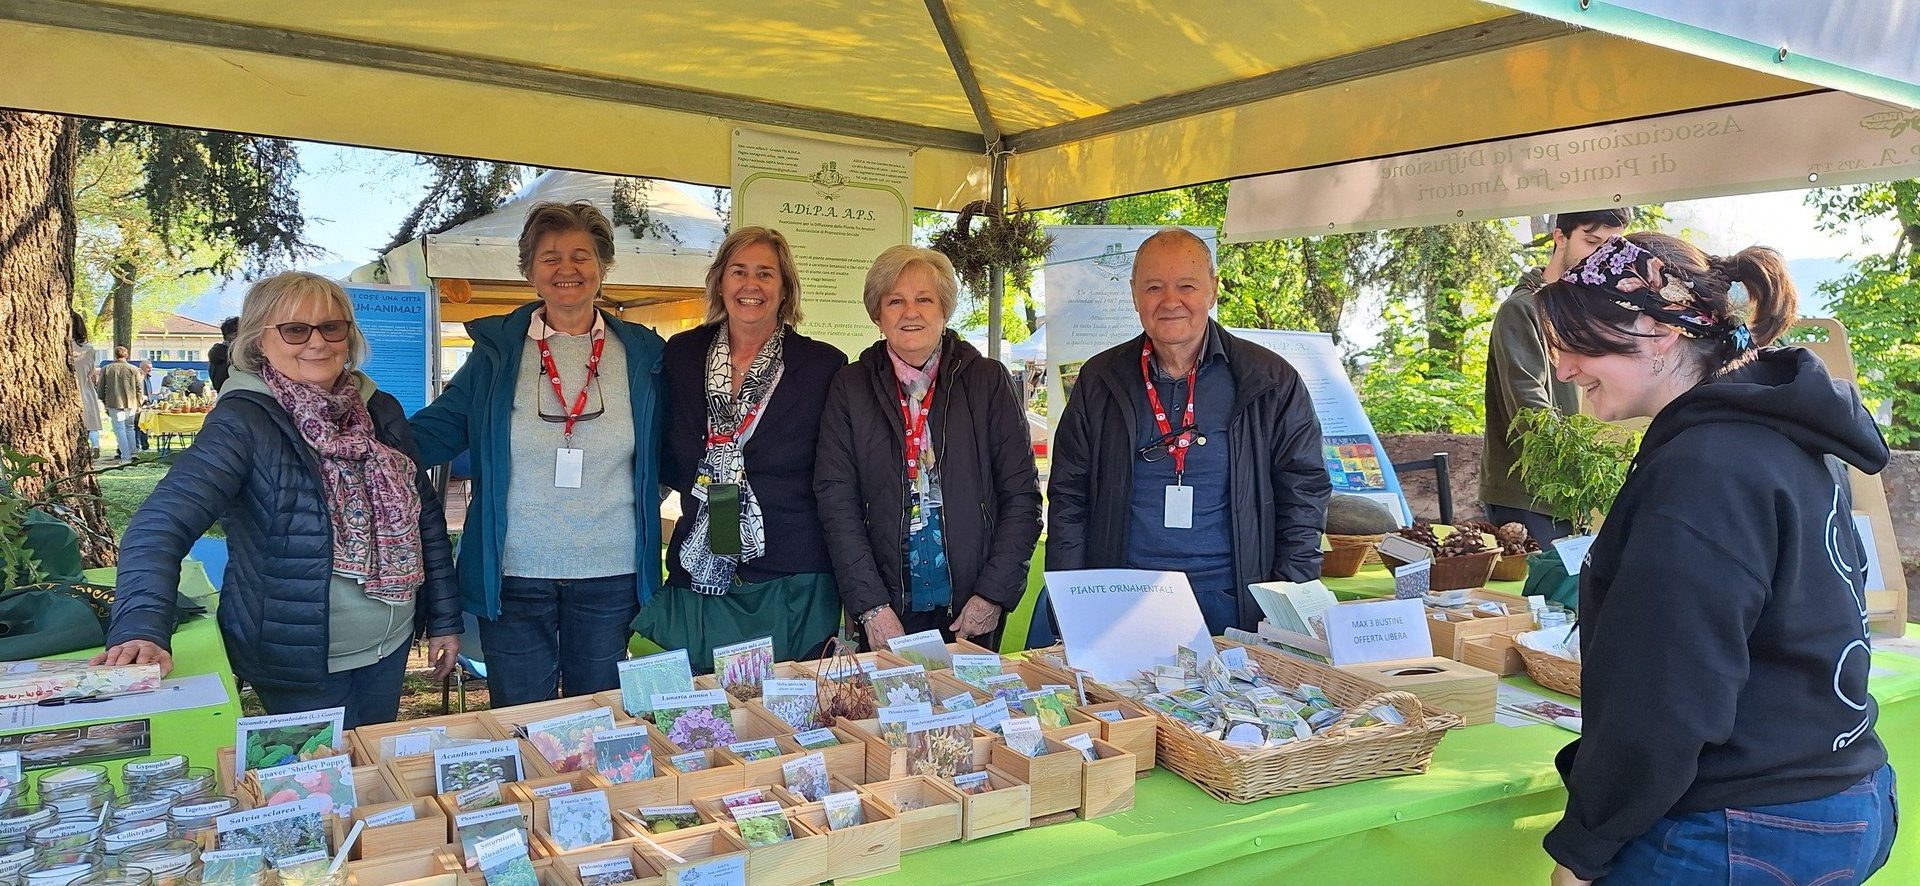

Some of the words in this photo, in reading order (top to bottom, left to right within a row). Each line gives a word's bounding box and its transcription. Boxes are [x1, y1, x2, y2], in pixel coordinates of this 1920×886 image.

[842, 208, 875, 221] A.P.S.
[353, 303, 422, 314] UM-ANIMAL?
[1070, 584, 1107, 595] PIANTE
[1108, 584, 1175, 594] ORNAMENTALI
[1352, 620, 1368, 628] MAX
[1375, 617, 1404, 627] BUSTINE
[1353, 634, 1383, 644] OFFERTA
[1384, 632, 1408, 641] LIBERA
[662, 693, 687, 701] Lunaria
[441, 750, 478, 760] Acanthus
[480, 746, 503, 755] mollis
[136, 761, 170, 770] Gypsophila
[260, 769, 286, 779] apaver
[230, 814, 260, 824] Salvia
[262, 807, 295, 817] sclarea
[481, 832, 516, 850] Smyrnium
[481, 845, 515, 861] olusatrum
